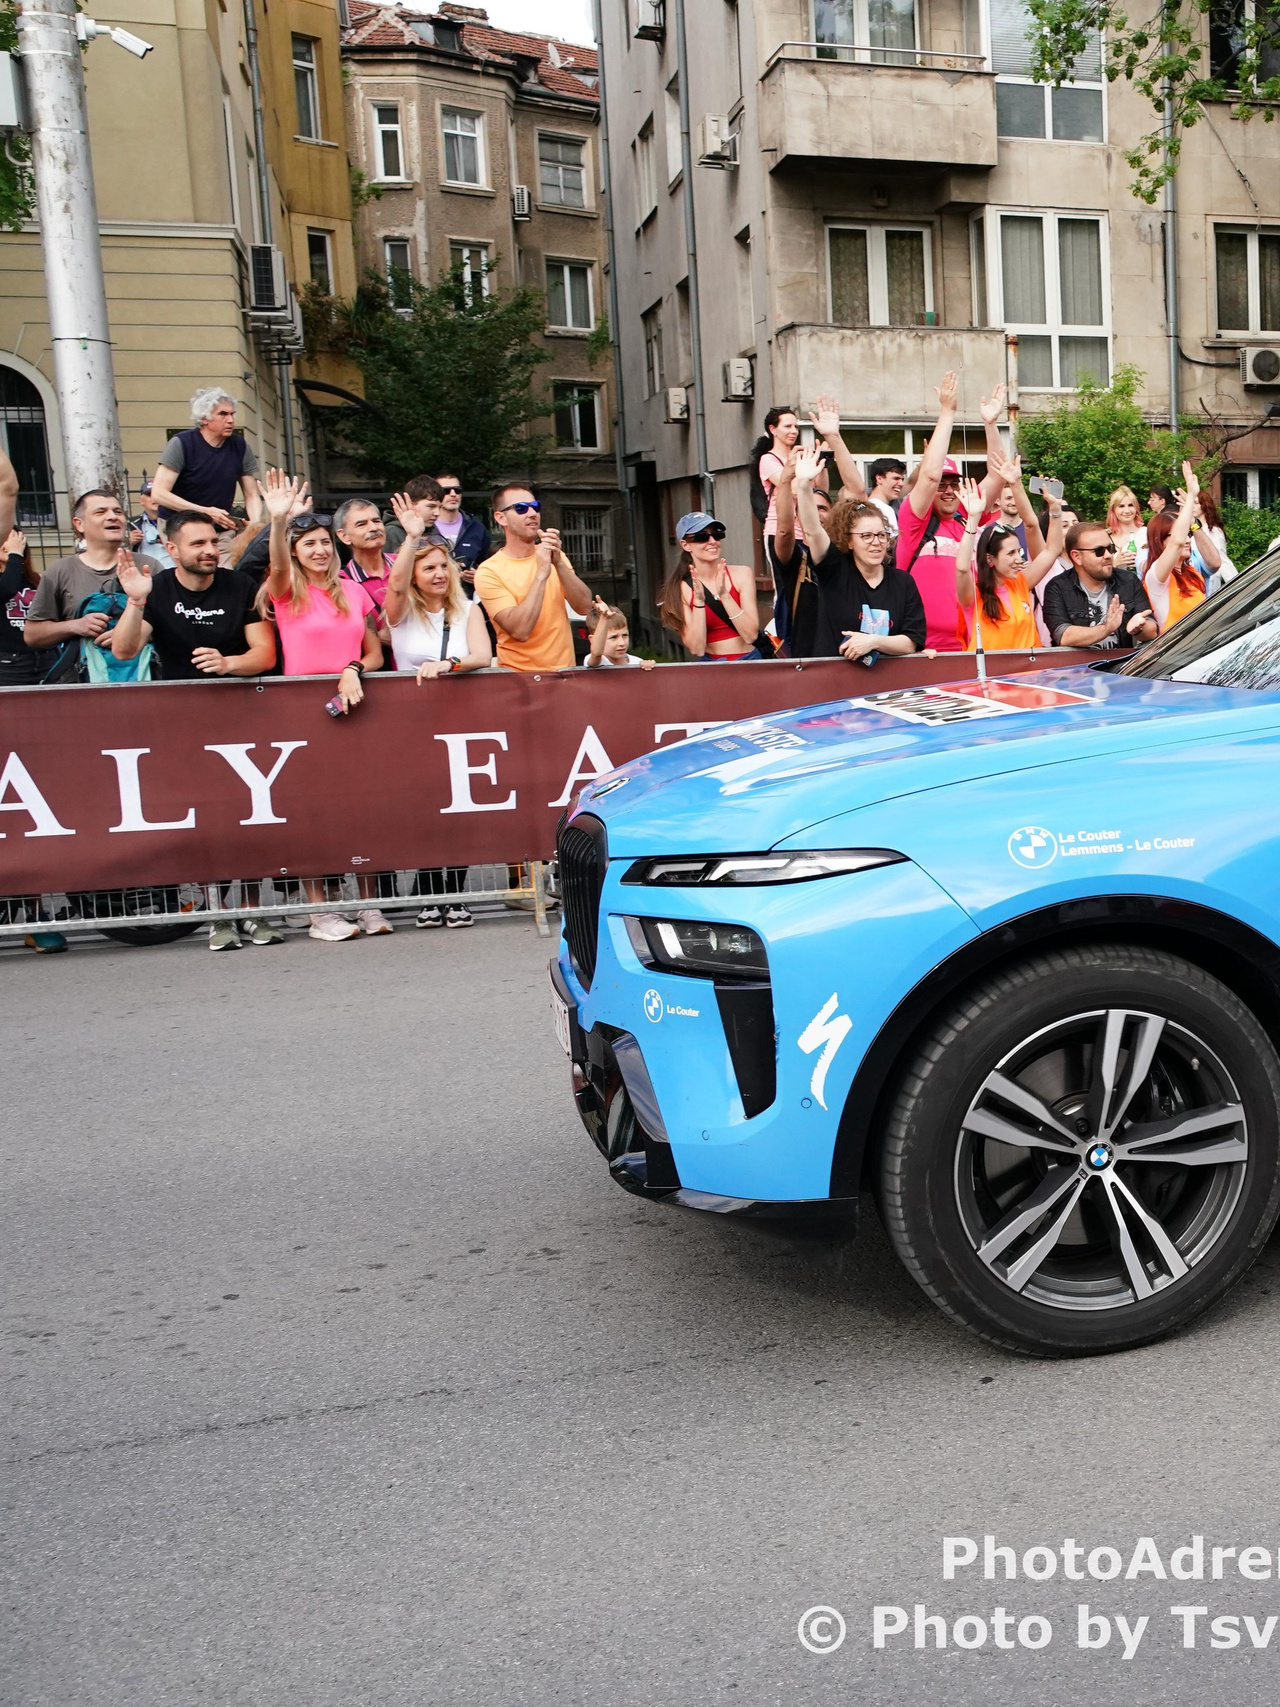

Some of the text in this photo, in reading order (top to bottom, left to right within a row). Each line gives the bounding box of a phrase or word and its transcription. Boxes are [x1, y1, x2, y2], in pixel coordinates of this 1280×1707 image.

[1013, 827, 1050, 841] BMW
[1058, 829, 1122, 844] Le Couter
[1060, 842, 1125, 857] Lemmens
[1134, 838, 1152, 852] Le
[1152, 836, 1197, 850] Couter
[666, 1004, 700, 1018] Le Couter
